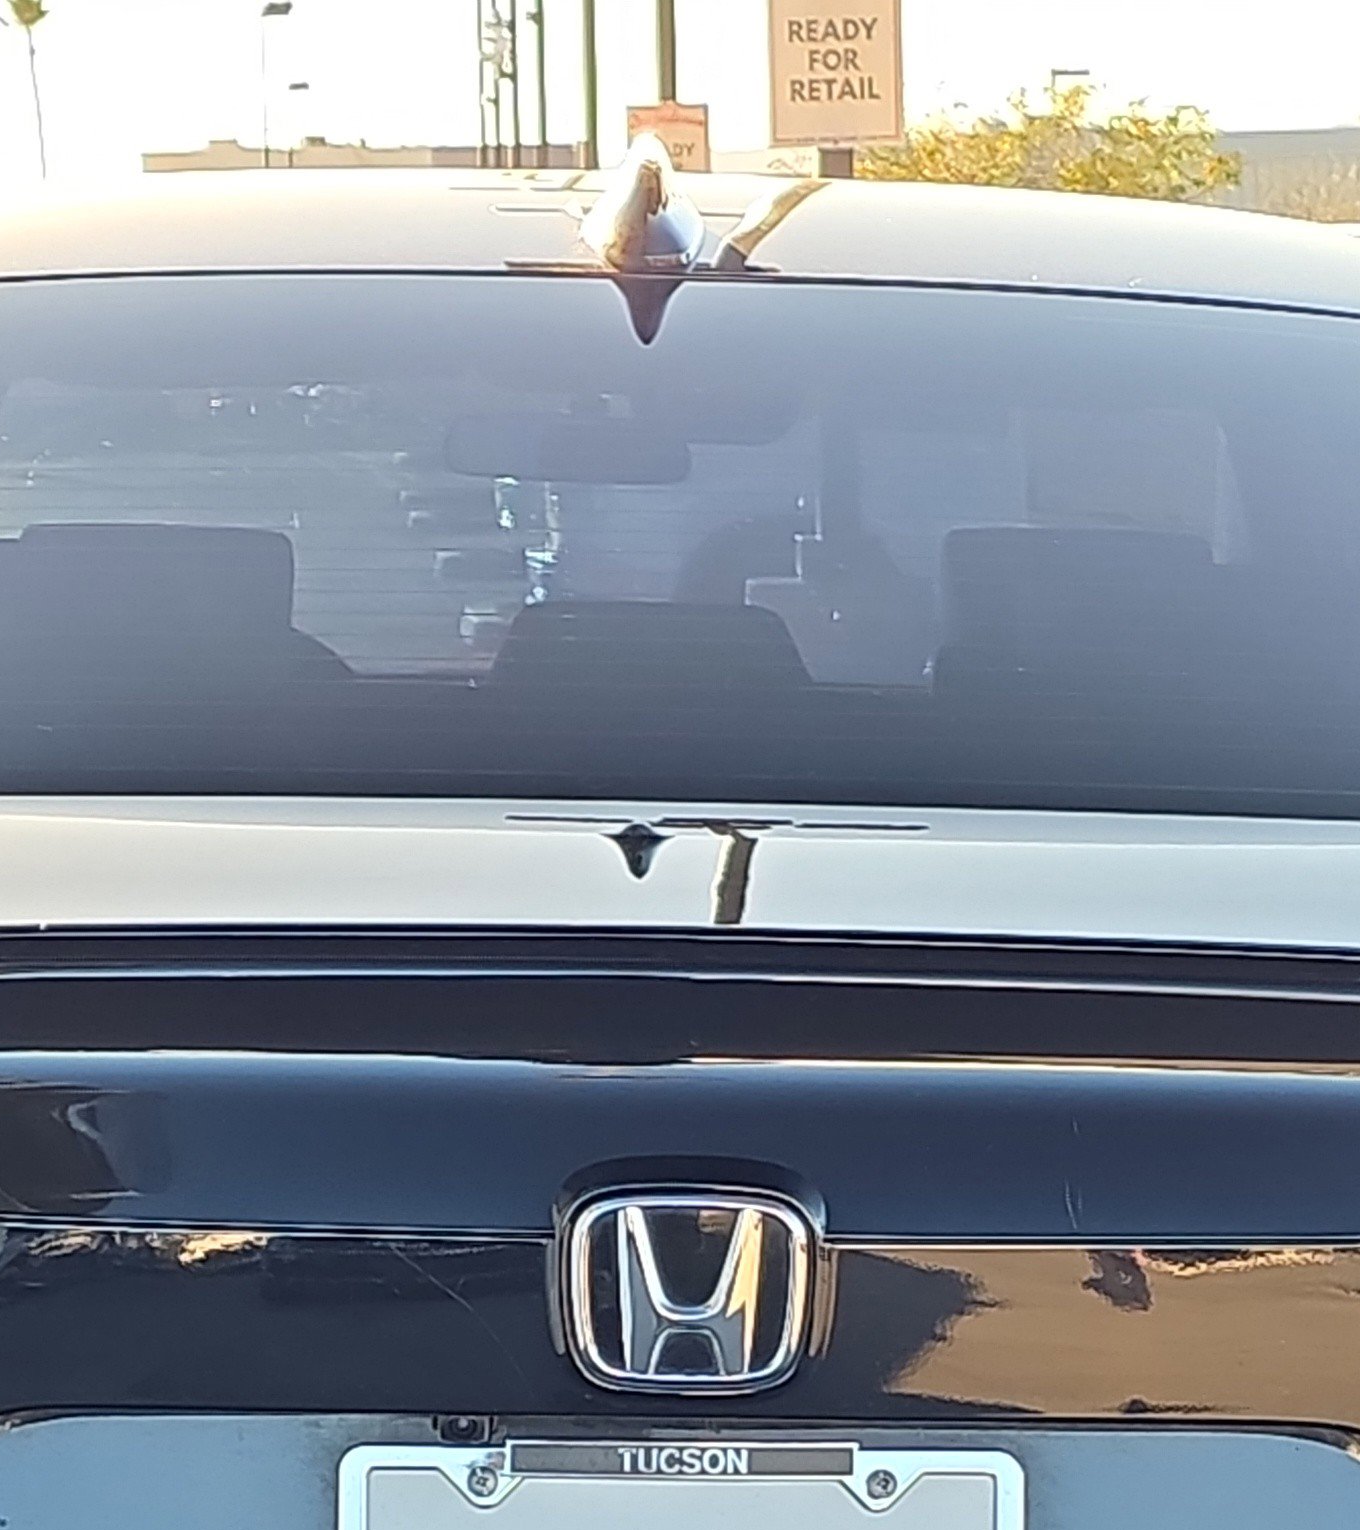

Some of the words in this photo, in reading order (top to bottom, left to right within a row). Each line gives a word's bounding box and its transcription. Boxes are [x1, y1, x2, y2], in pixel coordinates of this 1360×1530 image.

[787, 17, 878, 43] READY
[808, 47, 861, 72] FOR
[789, 75, 881, 102] RETAIL
[617, 1447, 749, 1474] TUCSON
